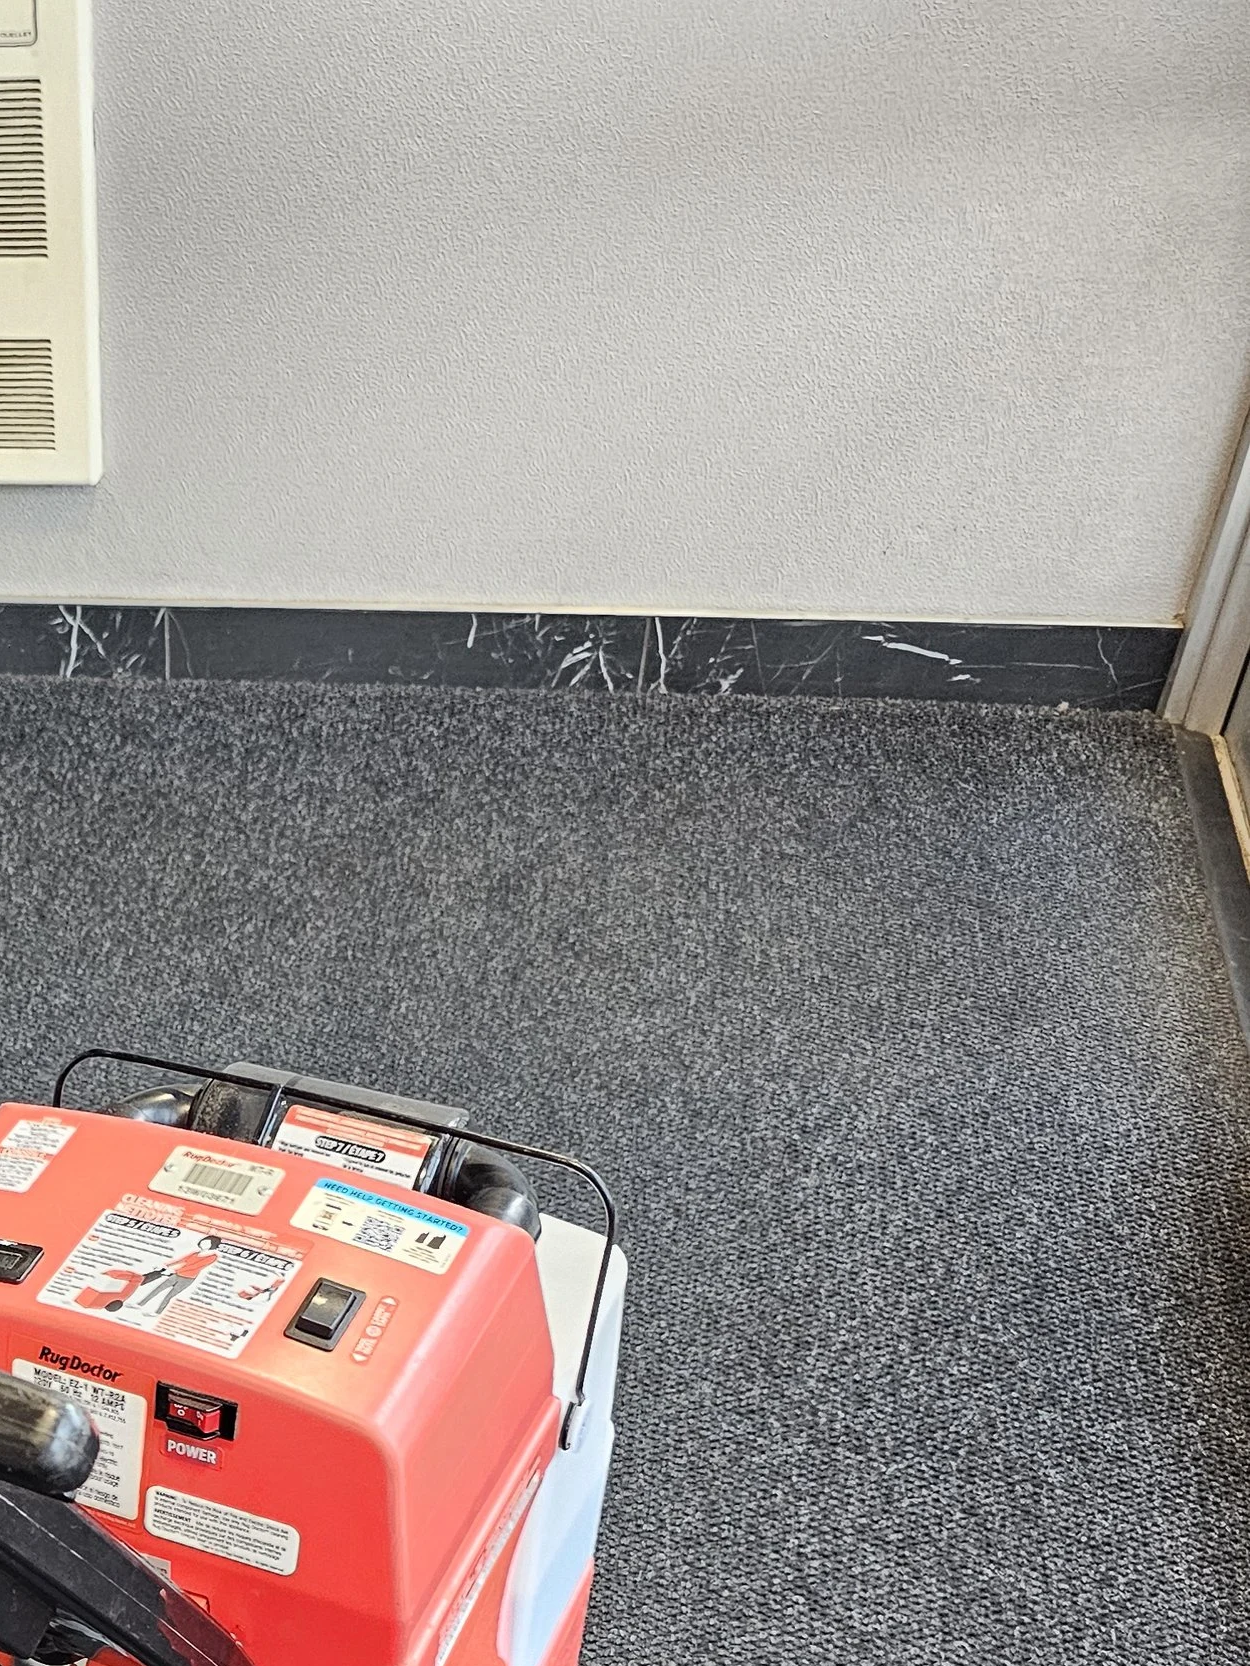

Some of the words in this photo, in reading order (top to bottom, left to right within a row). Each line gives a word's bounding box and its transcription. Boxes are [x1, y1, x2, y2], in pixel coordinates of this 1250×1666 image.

[315, 1137, 338, 1150] STEP
[324, 1182, 349, 1194] NEED
[350, 1190, 373, 1203] HELP
[376, 1198, 414, 1216] GETTING
[415, 1211, 463, 1233] STARTED?
[167, 1439, 217, 1465] POWER
